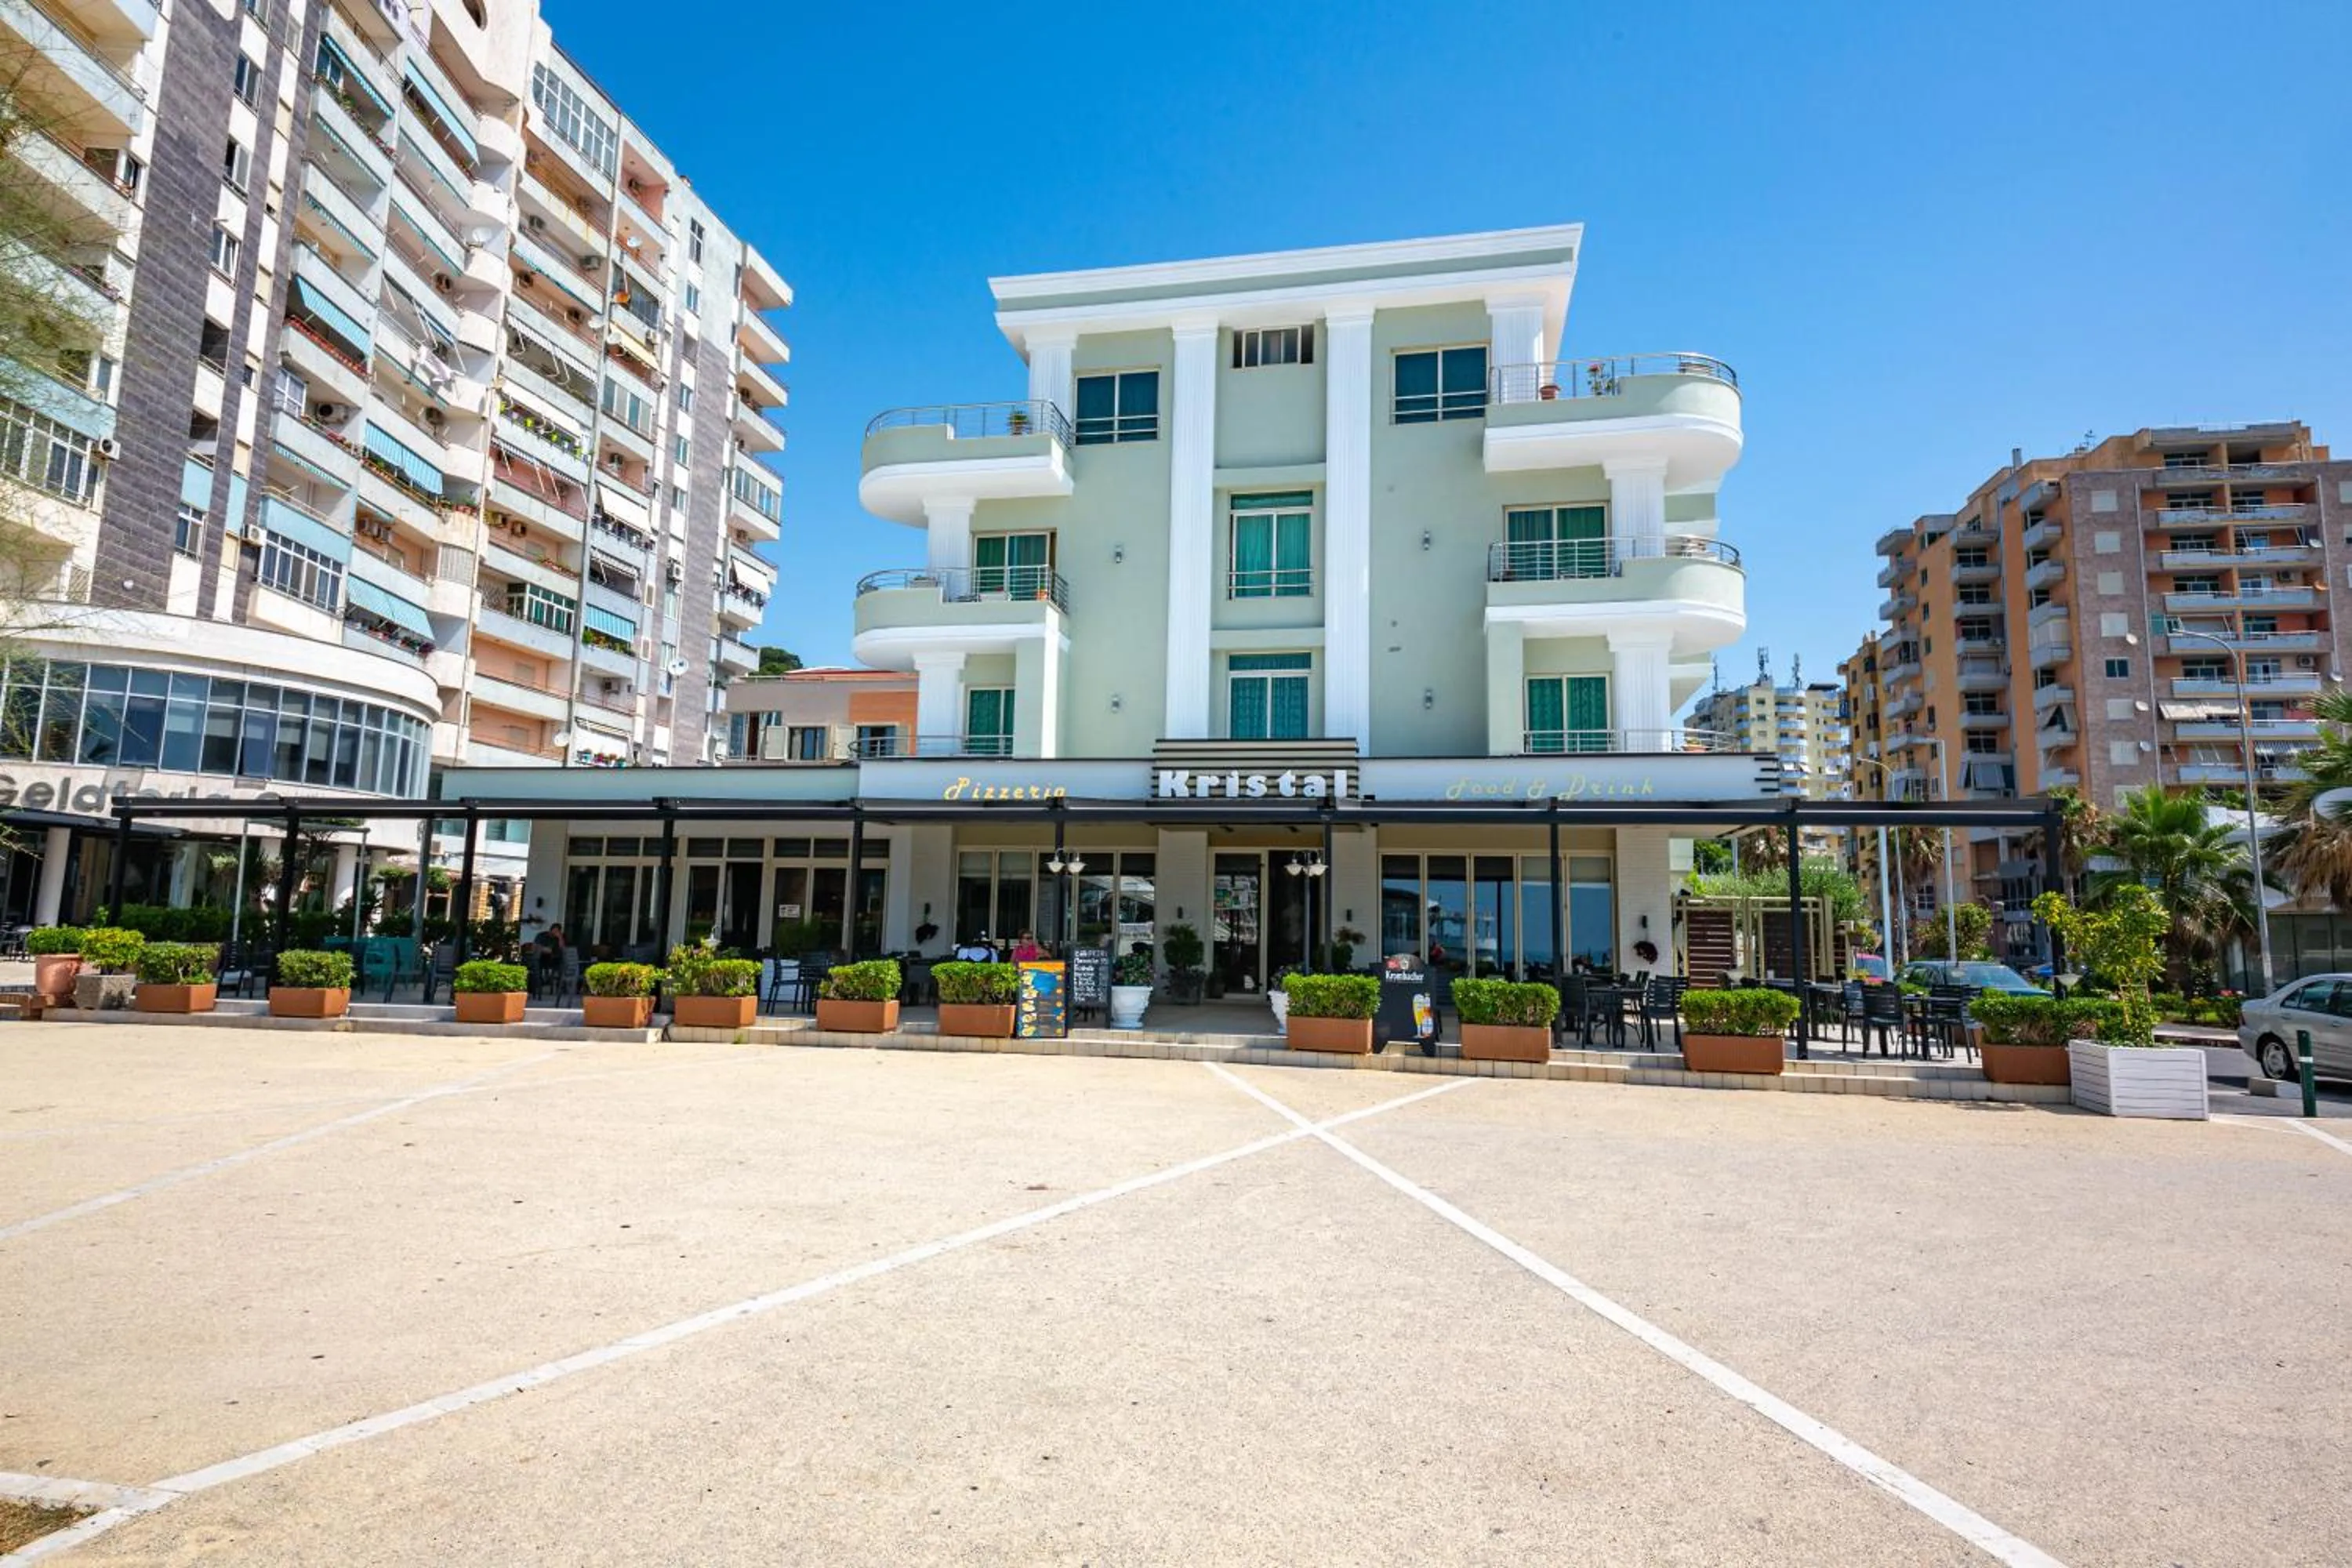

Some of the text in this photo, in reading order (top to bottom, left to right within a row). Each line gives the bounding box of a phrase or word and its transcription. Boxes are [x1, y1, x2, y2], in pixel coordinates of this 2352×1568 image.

[943, 777, 1066, 800] Pizzeria
[1158, 770, 1348, 798] Kristal
[1446, 775, 1518, 800] Food
[1557, 773, 1654, 800] Drink
